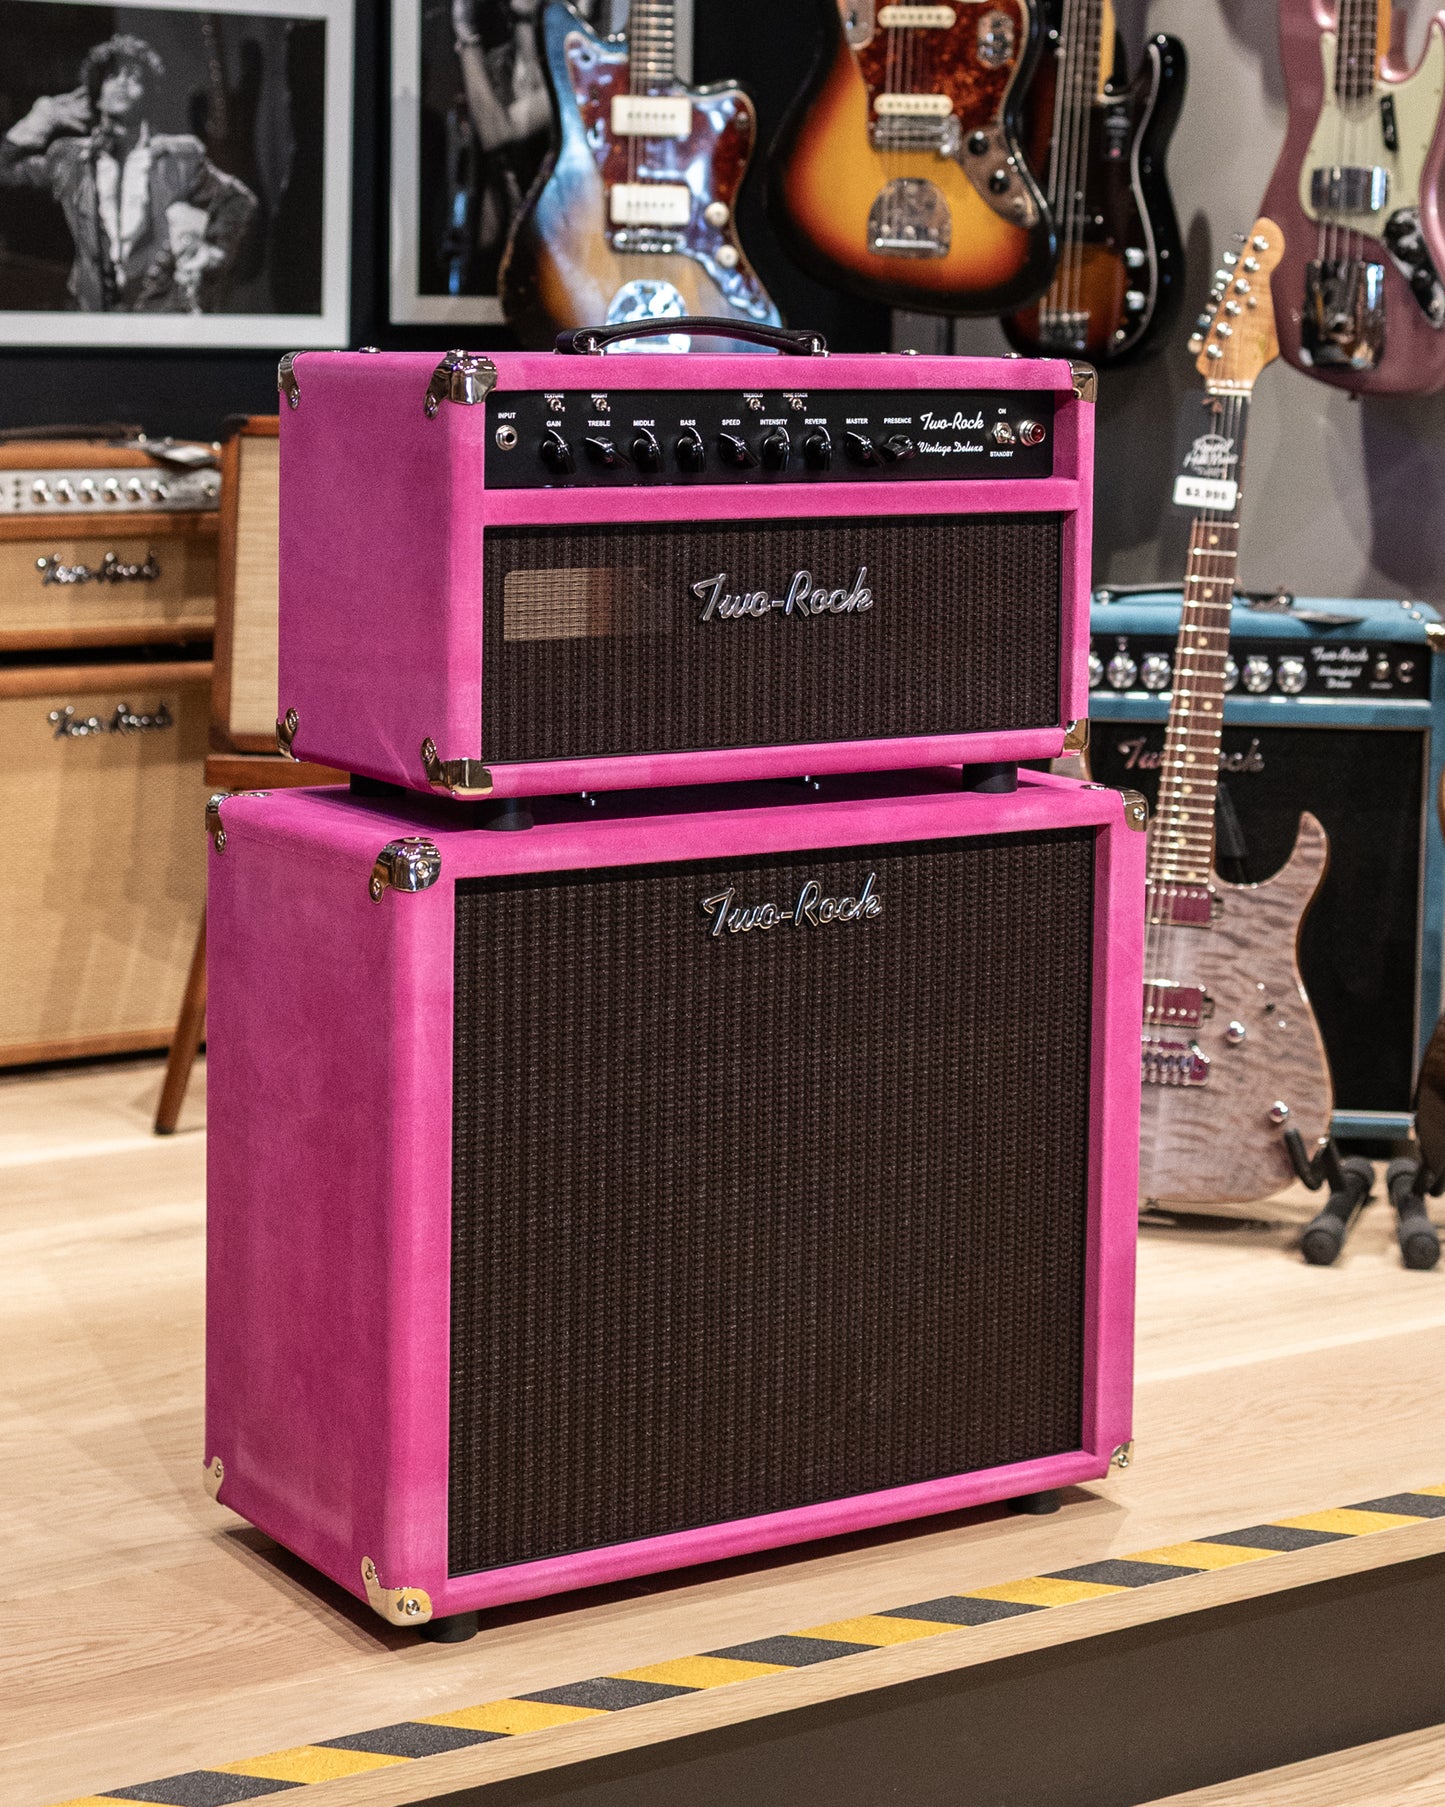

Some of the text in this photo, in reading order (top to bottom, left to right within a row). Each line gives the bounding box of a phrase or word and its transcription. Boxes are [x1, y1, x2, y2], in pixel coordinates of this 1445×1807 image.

[633, 419, 655, 427] MIDDLE
[760, 418, 788, 426] INTENSITY
[920, 411, 984, 430] Two-Rock
[953, 441, 984, 453] Deluxe
[692, 566, 874, 622] Two-Rock
[702, 872, 883, 937] Two-Rock
